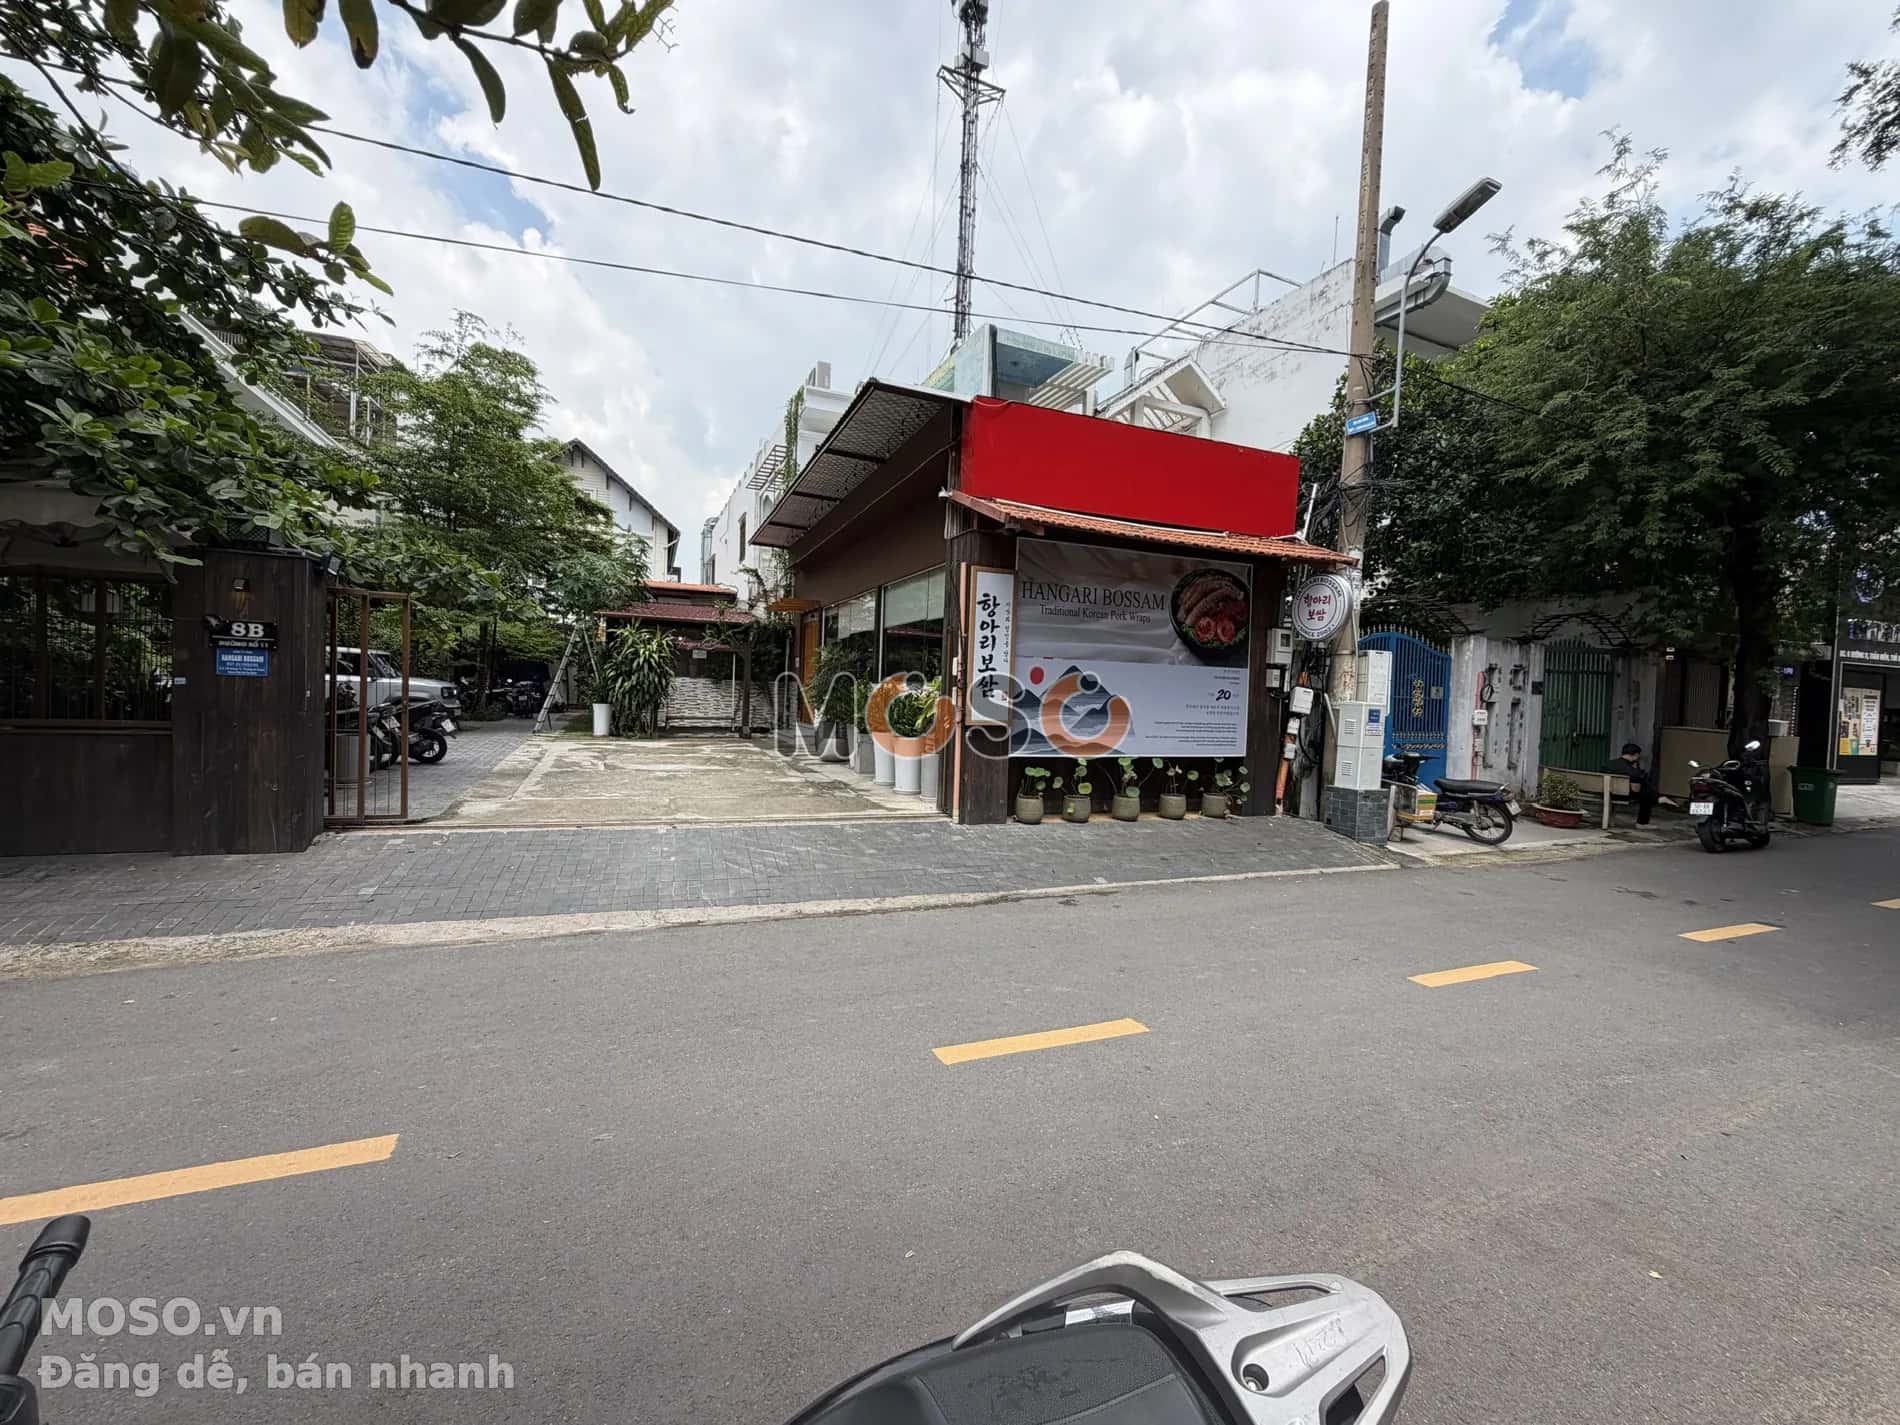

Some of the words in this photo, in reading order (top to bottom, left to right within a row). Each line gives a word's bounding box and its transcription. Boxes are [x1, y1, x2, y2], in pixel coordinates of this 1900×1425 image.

[1022, 581, 1097, 605] HANGARI
[1103, 588, 1165, 610] BOSSAM
[1303, 593, 1331, 608] 항아리
[1040, 604, 1080, 617] Traditional
[1082, 607, 1109, 619] Korean
[1110, 610, 1127, 621] Pork
[1129, 611, 1151, 624] Wraps
[231, 622, 264, 638] 8B
[1216, 689, 1231, 701] 20
